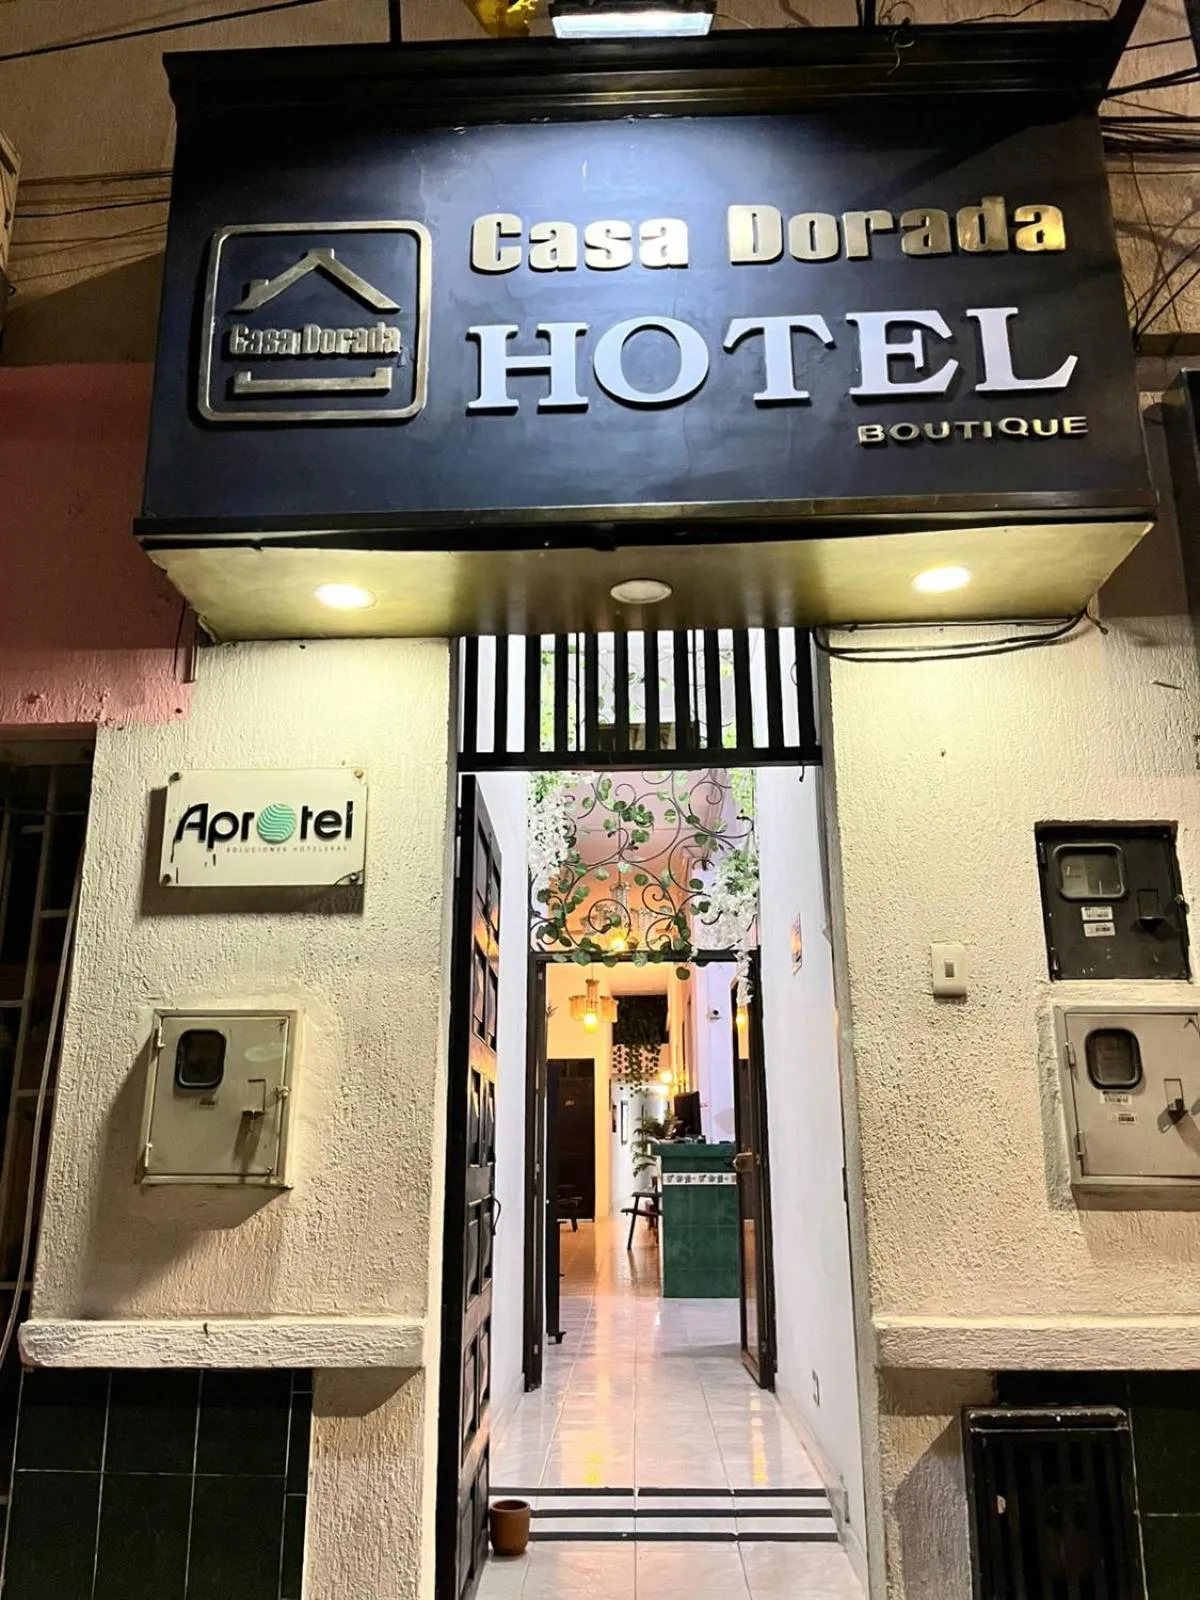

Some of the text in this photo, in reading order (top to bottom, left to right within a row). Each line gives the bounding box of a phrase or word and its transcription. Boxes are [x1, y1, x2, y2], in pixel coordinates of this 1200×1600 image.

[471, 196, 1066, 273] Casa Dorada
[229, 320, 401, 356] Casa Dorada
[465, 306, 1078, 412] HOTEL
[857, 415, 1089, 445] BOUTIQUE
